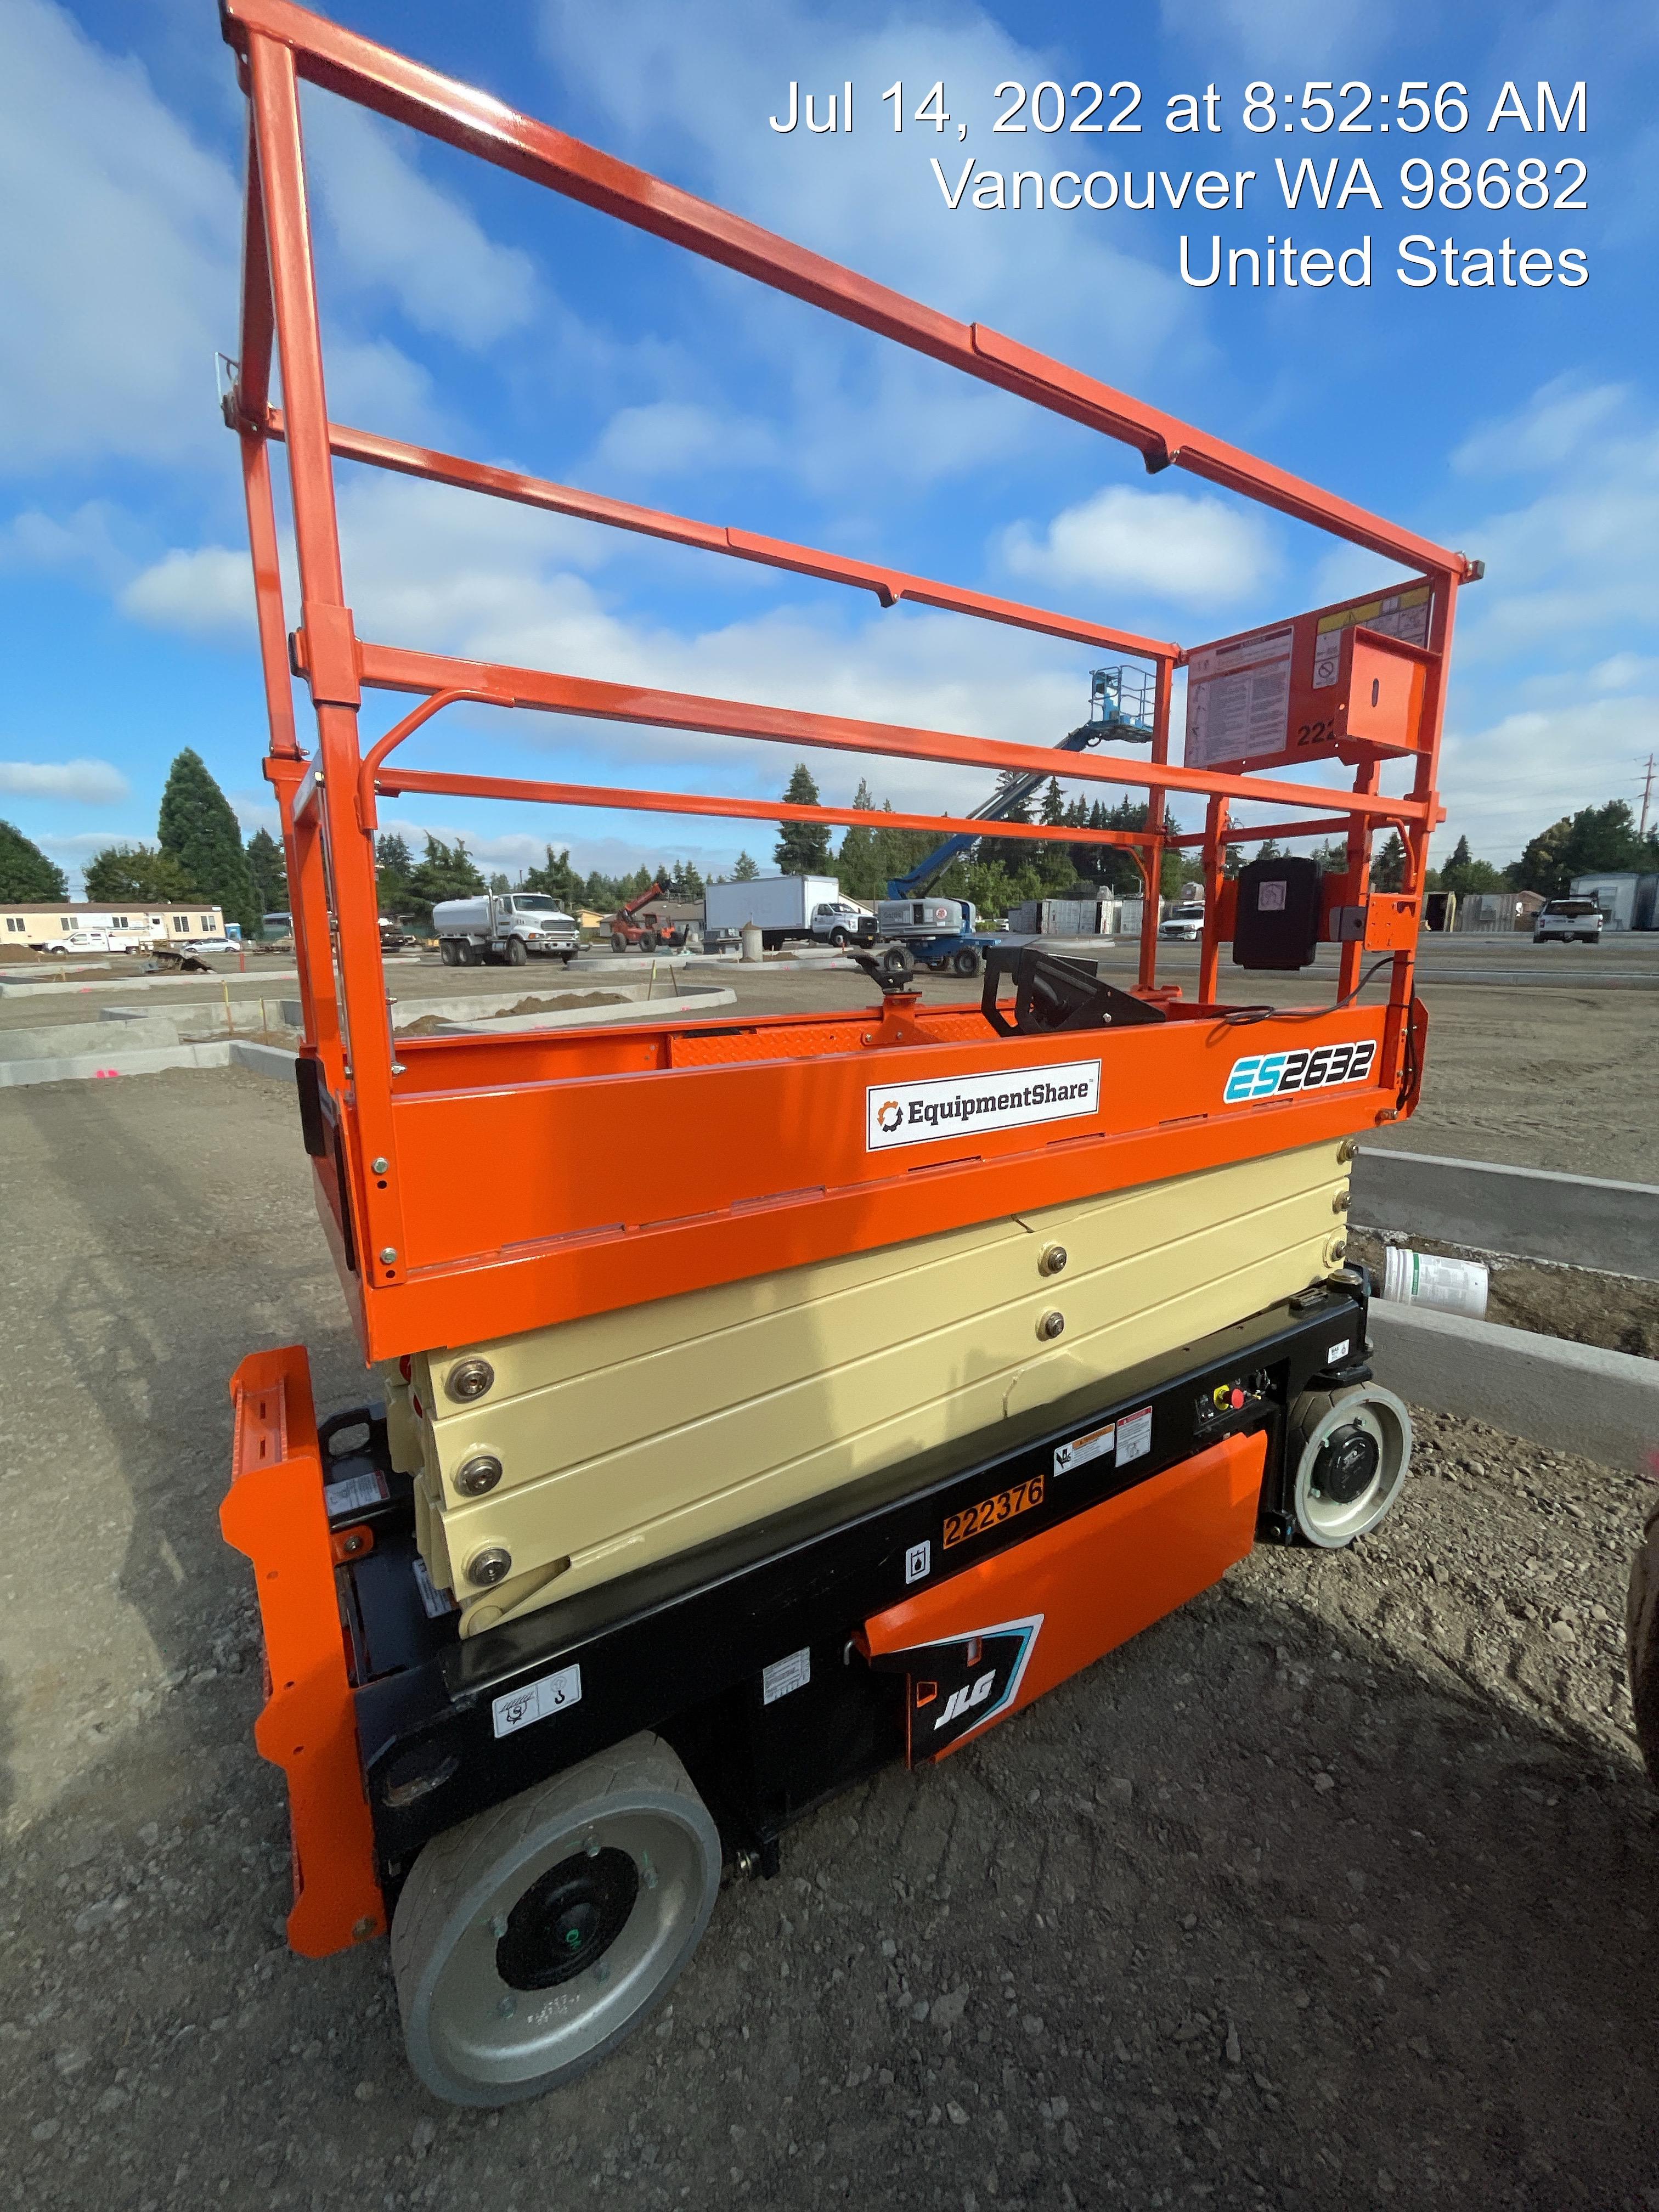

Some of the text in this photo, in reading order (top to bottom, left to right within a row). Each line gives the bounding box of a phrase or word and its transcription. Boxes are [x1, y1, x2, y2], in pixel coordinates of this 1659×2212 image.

[1226, 1043, 1375, 1099] ES2632
[945, 1477, 1042, 1546] 222376
[933, 1668, 996, 1730] JLG
